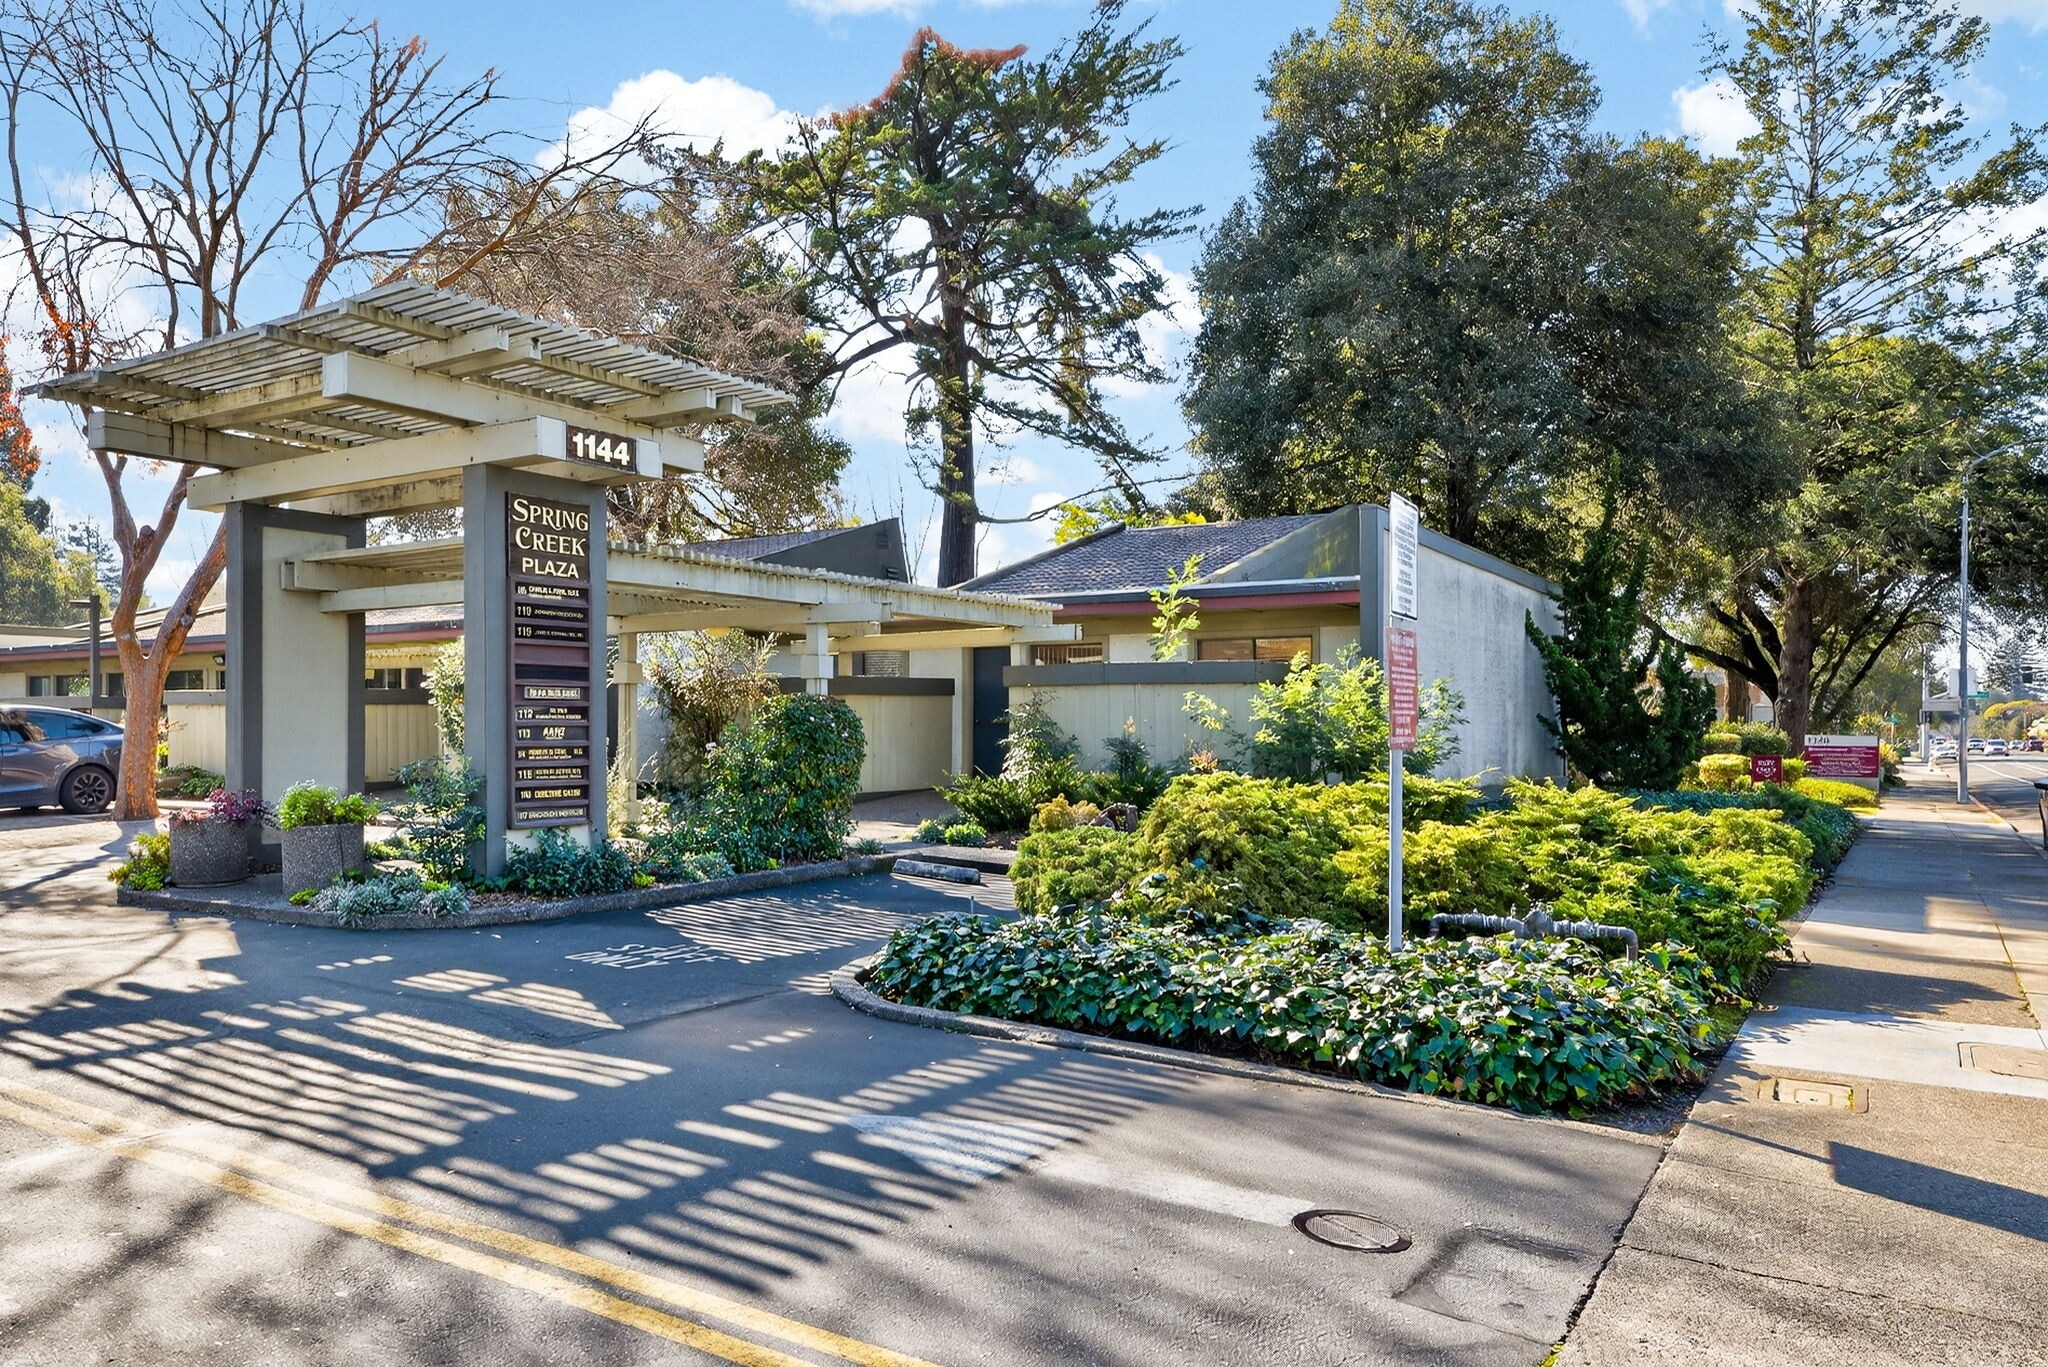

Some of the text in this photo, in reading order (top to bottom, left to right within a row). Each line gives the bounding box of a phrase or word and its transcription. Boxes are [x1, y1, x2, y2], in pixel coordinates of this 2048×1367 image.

[573, 432, 630, 466] 1144
[512, 498, 589, 531] SPRING
[515, 526, 586, 556] CREEK
[522, 556, 579, 579] PLAZA
[564, 952, 669, 969] ONLY
